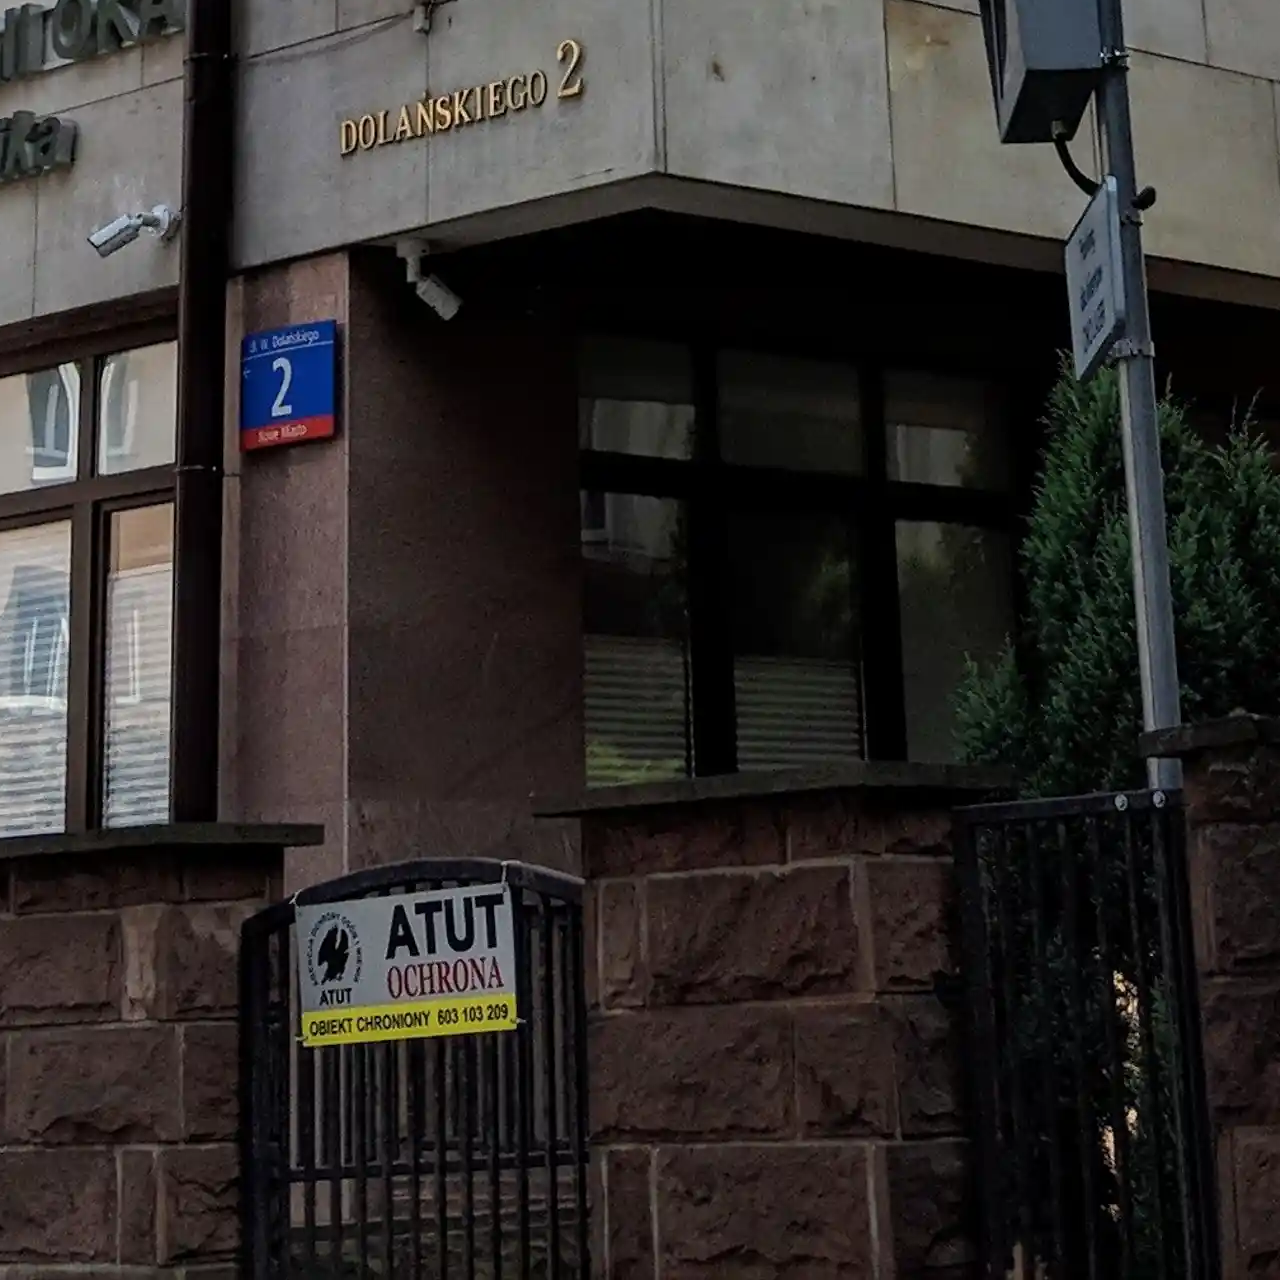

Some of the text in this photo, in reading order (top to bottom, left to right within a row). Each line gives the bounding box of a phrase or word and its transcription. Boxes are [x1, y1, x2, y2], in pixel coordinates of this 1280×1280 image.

[338, 39, 585, 157] DOLAŃSKIEGO 2
[271, 357, 293, 417] 2
[385, 893, 505, 960] ATUT
[319, 987, 353, 1006] ATUT
[386, 955, 505, 1000] OCHRONA
[309, 1003, 508, 1038] OBIEKT CHRONIONY 603 103 209
